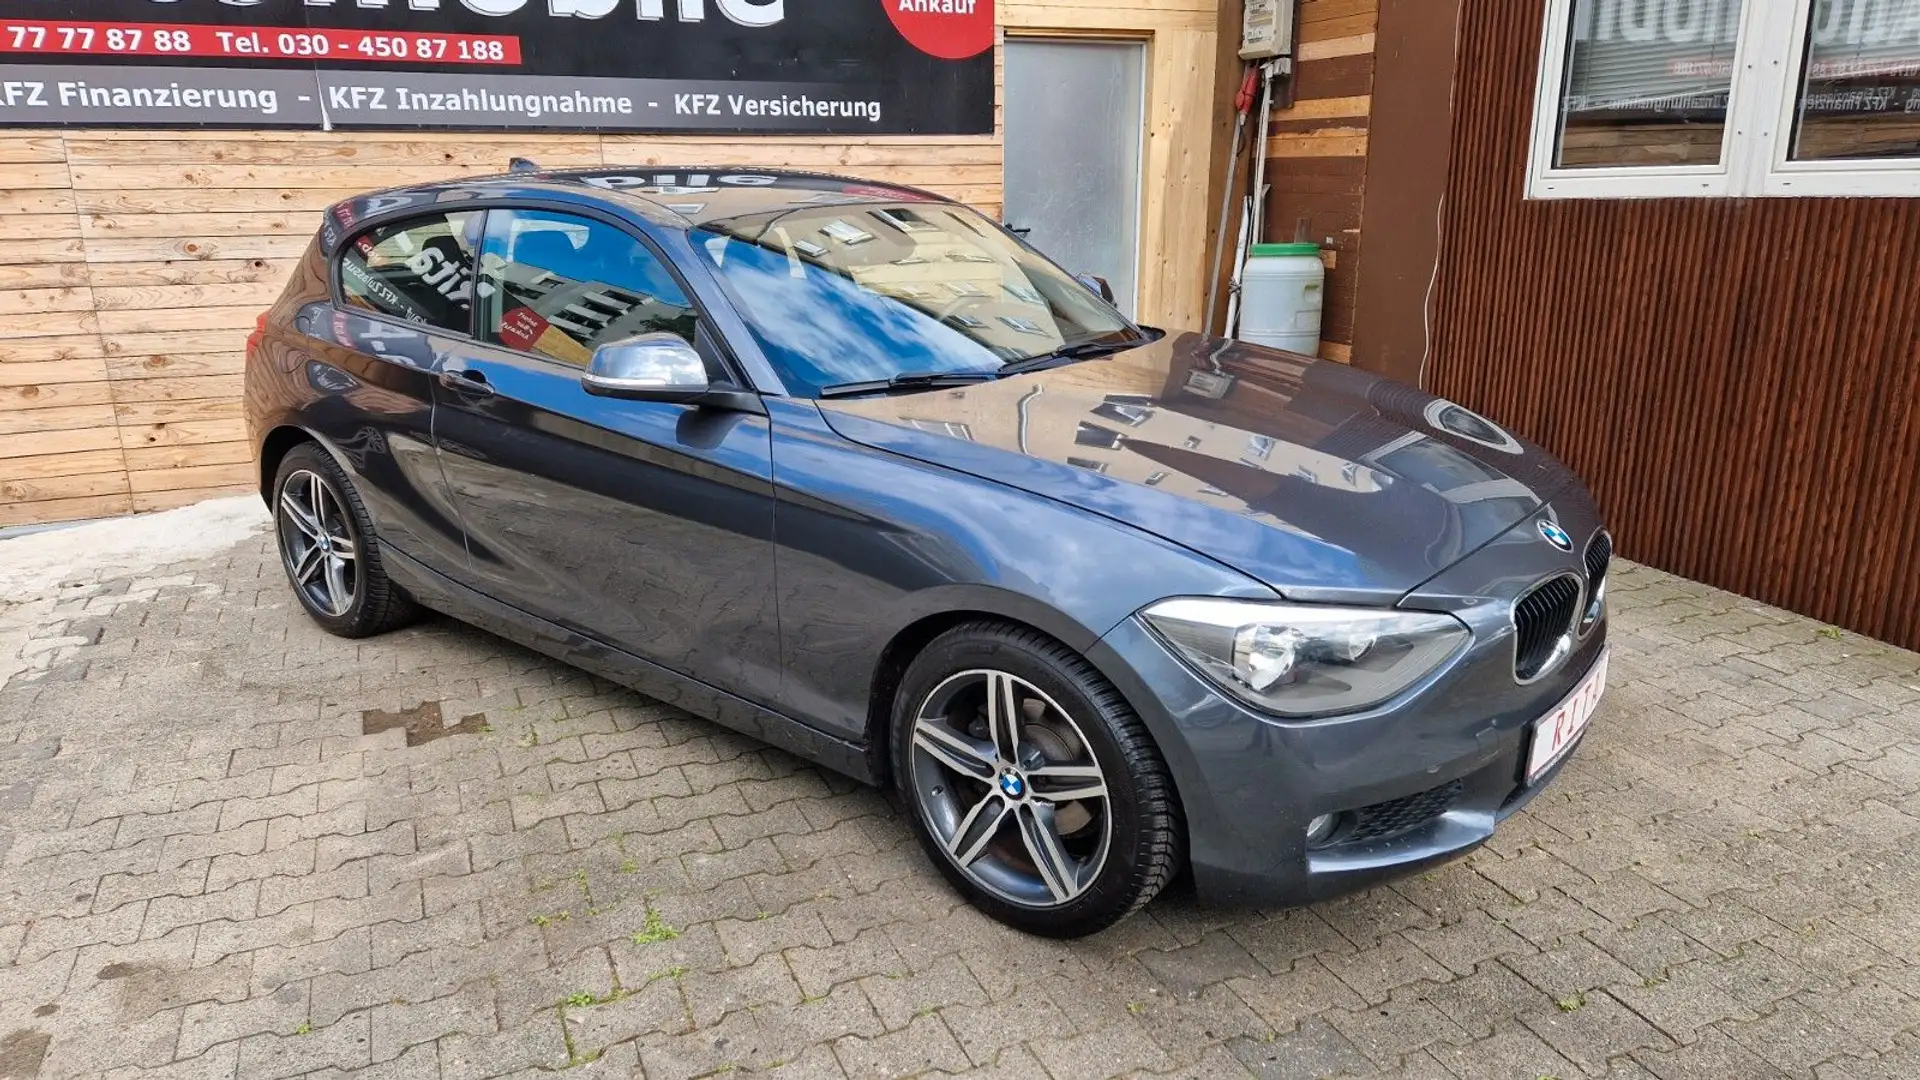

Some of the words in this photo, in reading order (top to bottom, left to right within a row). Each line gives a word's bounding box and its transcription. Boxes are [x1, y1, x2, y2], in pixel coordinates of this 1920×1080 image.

[899, 0, 976, 14] Ankauf
[8, 26, 46, 48] 77
[57, 27, 95, 49] 77
[106, 28, 142, 50] 87
[154, 30, 191, 51] 88
[216, 31, 269, 53] Tel.
[278, 33, 329, 55] 030
[358, 36, 408, 58] 450
[416, 38, 447, 59] 87
[458, 40, 504, 60] 188
[0, 81, 48, 106] FZ
[57, 81, 278, 114] Finanzierung
[329, 86, 387, 109] KFZ
[396, 87, 632, 117] Inzahlungnahme
[674, 94, 721, 115] KFZ
[728, 95, 881, 122] Versicherung
